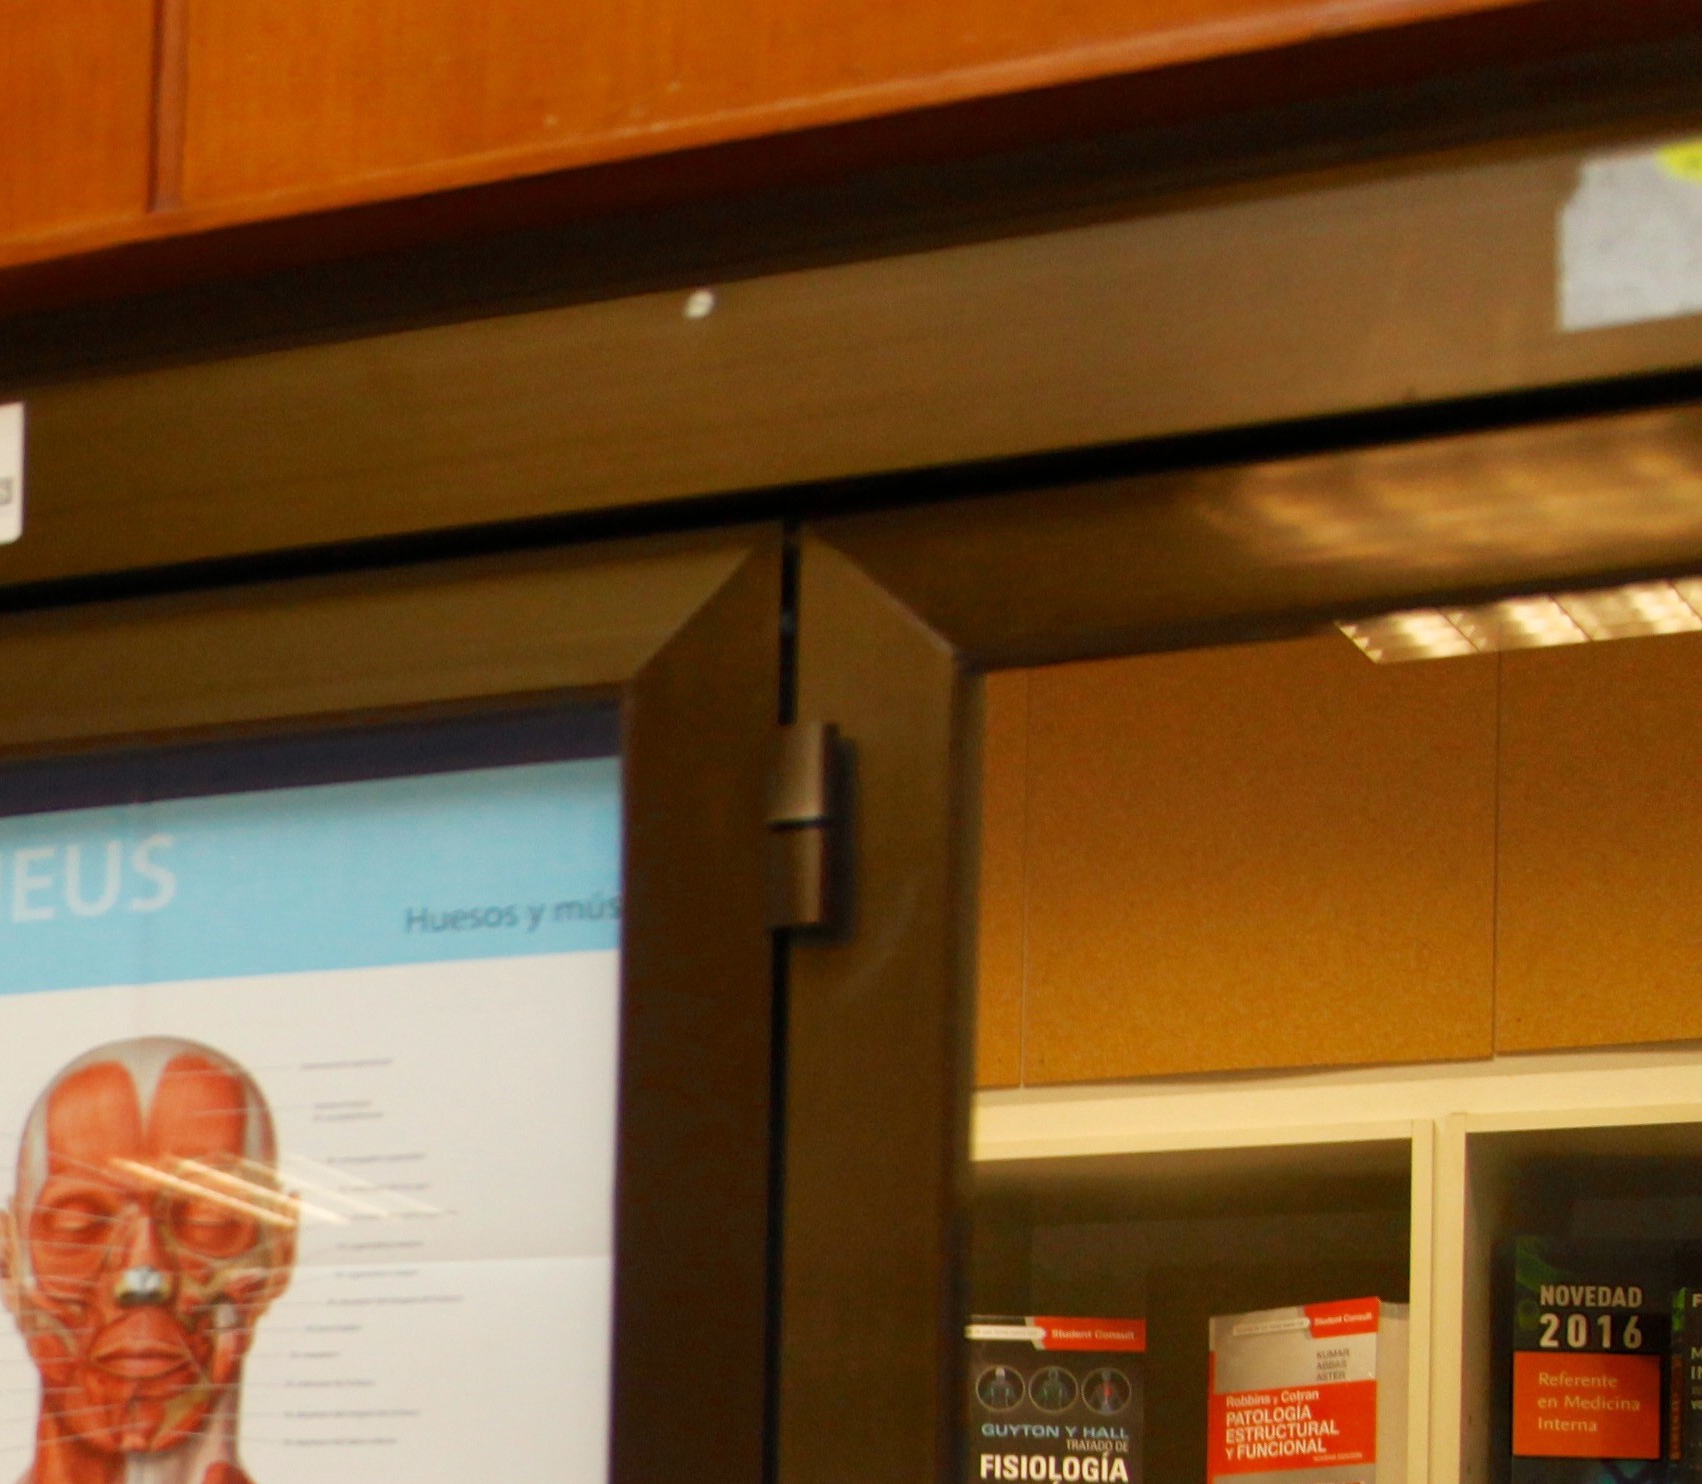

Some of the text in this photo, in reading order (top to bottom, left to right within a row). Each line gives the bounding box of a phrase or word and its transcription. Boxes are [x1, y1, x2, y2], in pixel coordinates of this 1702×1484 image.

[405, 904, 519, 934] Huesos
[526, 904, 547, 934] y
[1539, 1285, 1643, 1308] NOVEDAD
[1052, 1329, 1092, 1340] Student
[1094, 1329, 1135, 1341] Consult
[1539, 1313, 1642, 1349] 2016
[1316, 1348, 1349, 1359] KUMAR
[1538, 1371, 1619, 1390] Referente
[1226, 1390, 1319, 1409] Robbins Cotran
[1537, 1394, 1642, 1412] en Medicina
[1226, 1402, 1312, 1428] PATOLOGÍA
[1538, 1416, 1598, 1433] Interna
[981, 1423, 1129, 1440] GUYTON Y HALL
[1226, 1419, 1340, 1445] ESTRUCTURAL
[1066, 1439, 1130, 1453] TRATADO DE
[1226, 1438, 1327, 1461] Y FUNCIONAL
[980, 1450, 1130, 1483] FISIOLOGÍA
